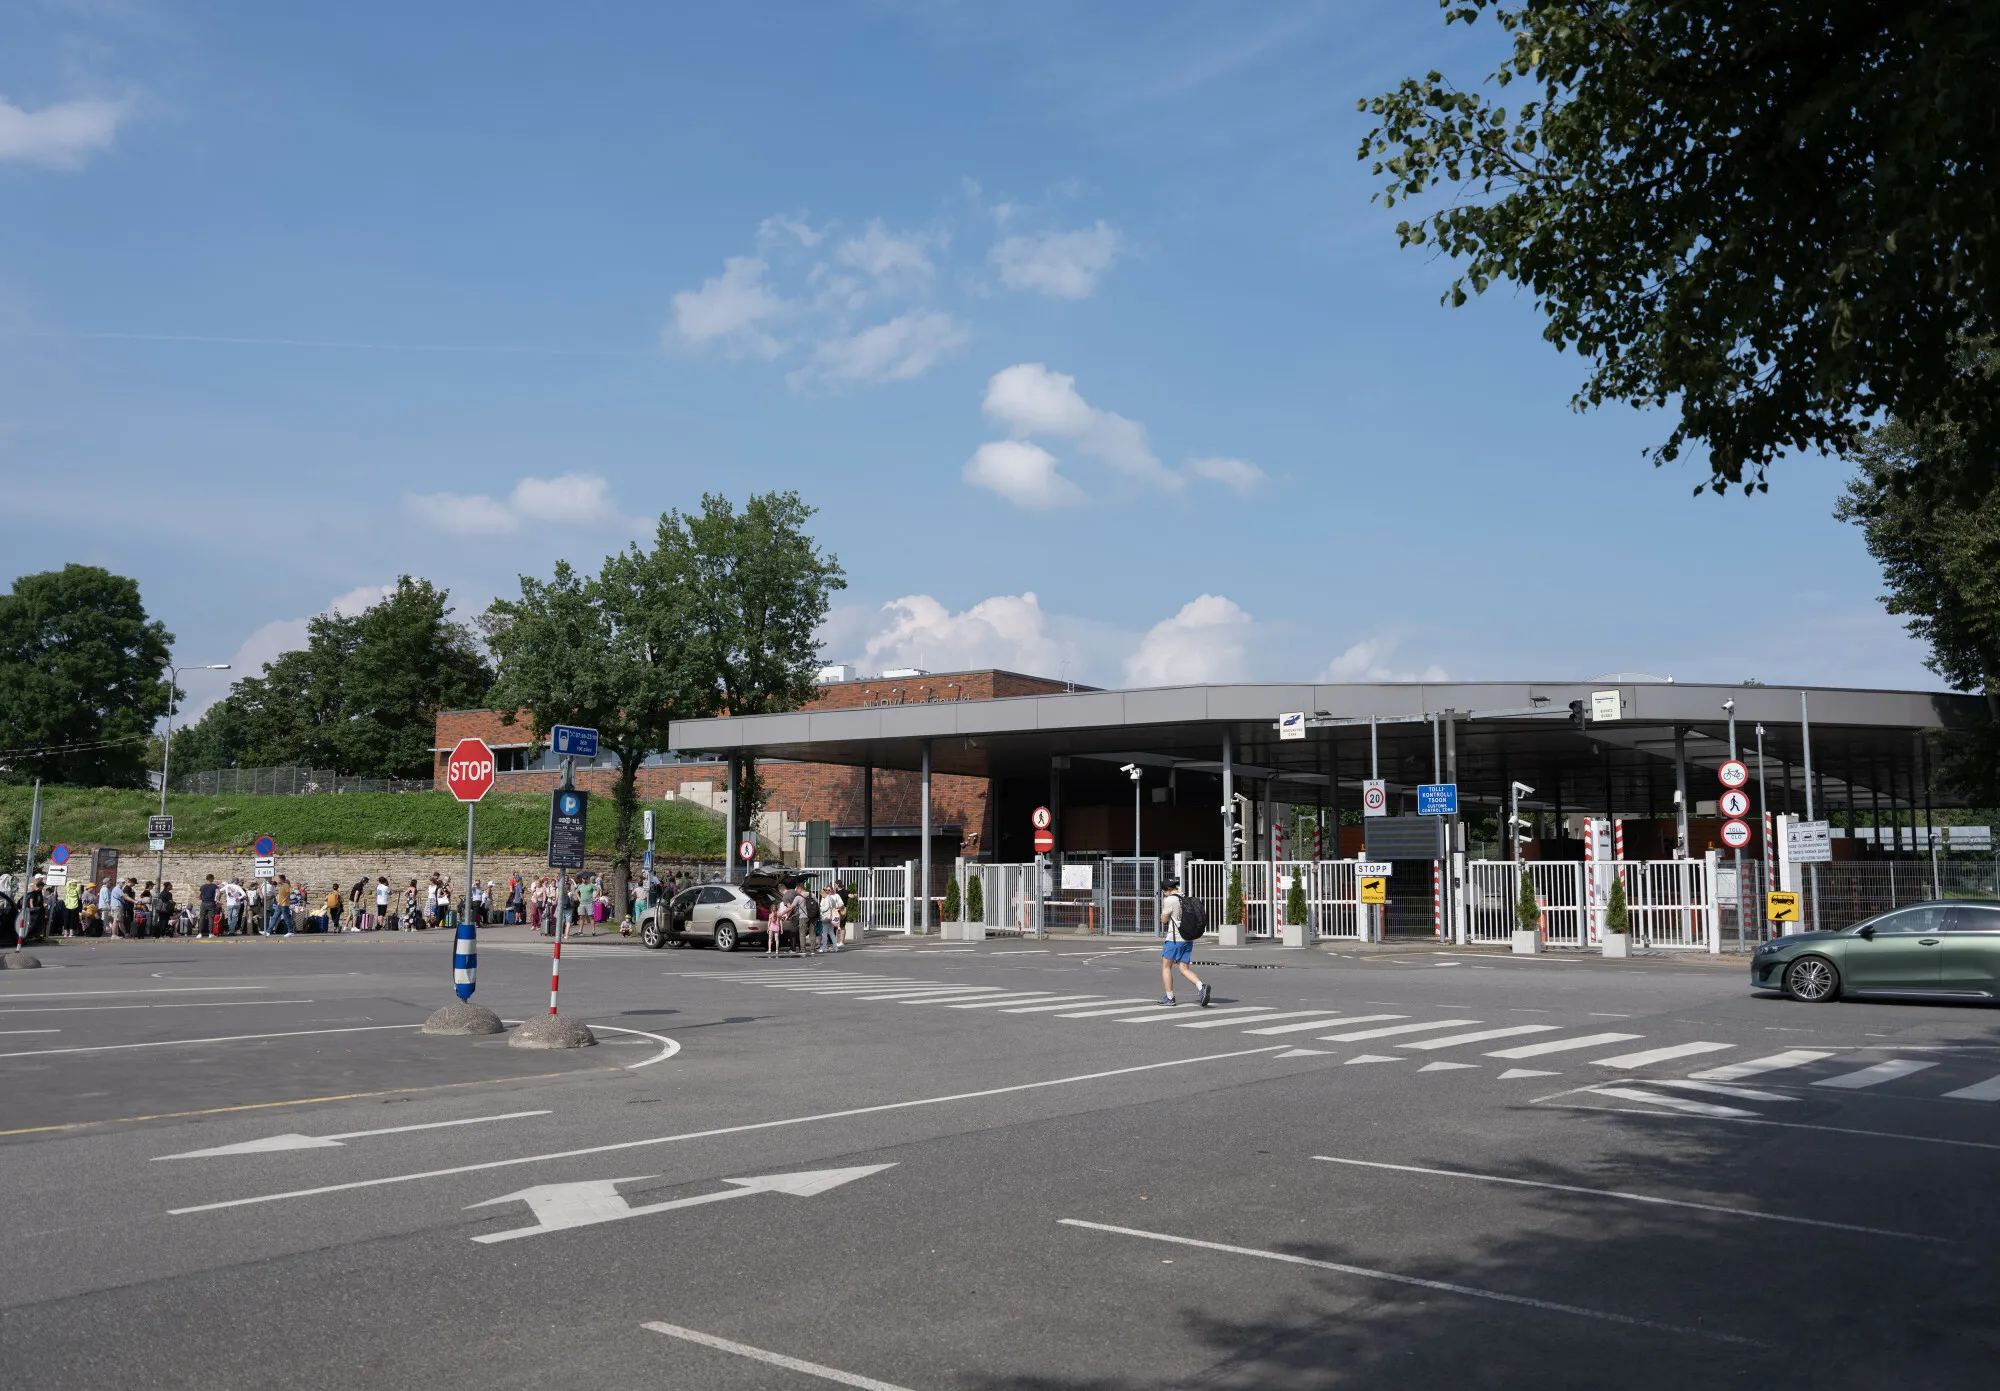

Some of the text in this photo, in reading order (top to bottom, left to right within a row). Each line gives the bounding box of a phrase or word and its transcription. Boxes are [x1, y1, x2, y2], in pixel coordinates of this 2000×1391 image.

[450, 760, 492, 782] STOP
[565, 796, 577, 812] P
[1370, 793, 1380, 803] 20
[1358, 865, 1387, 873] STOPP
